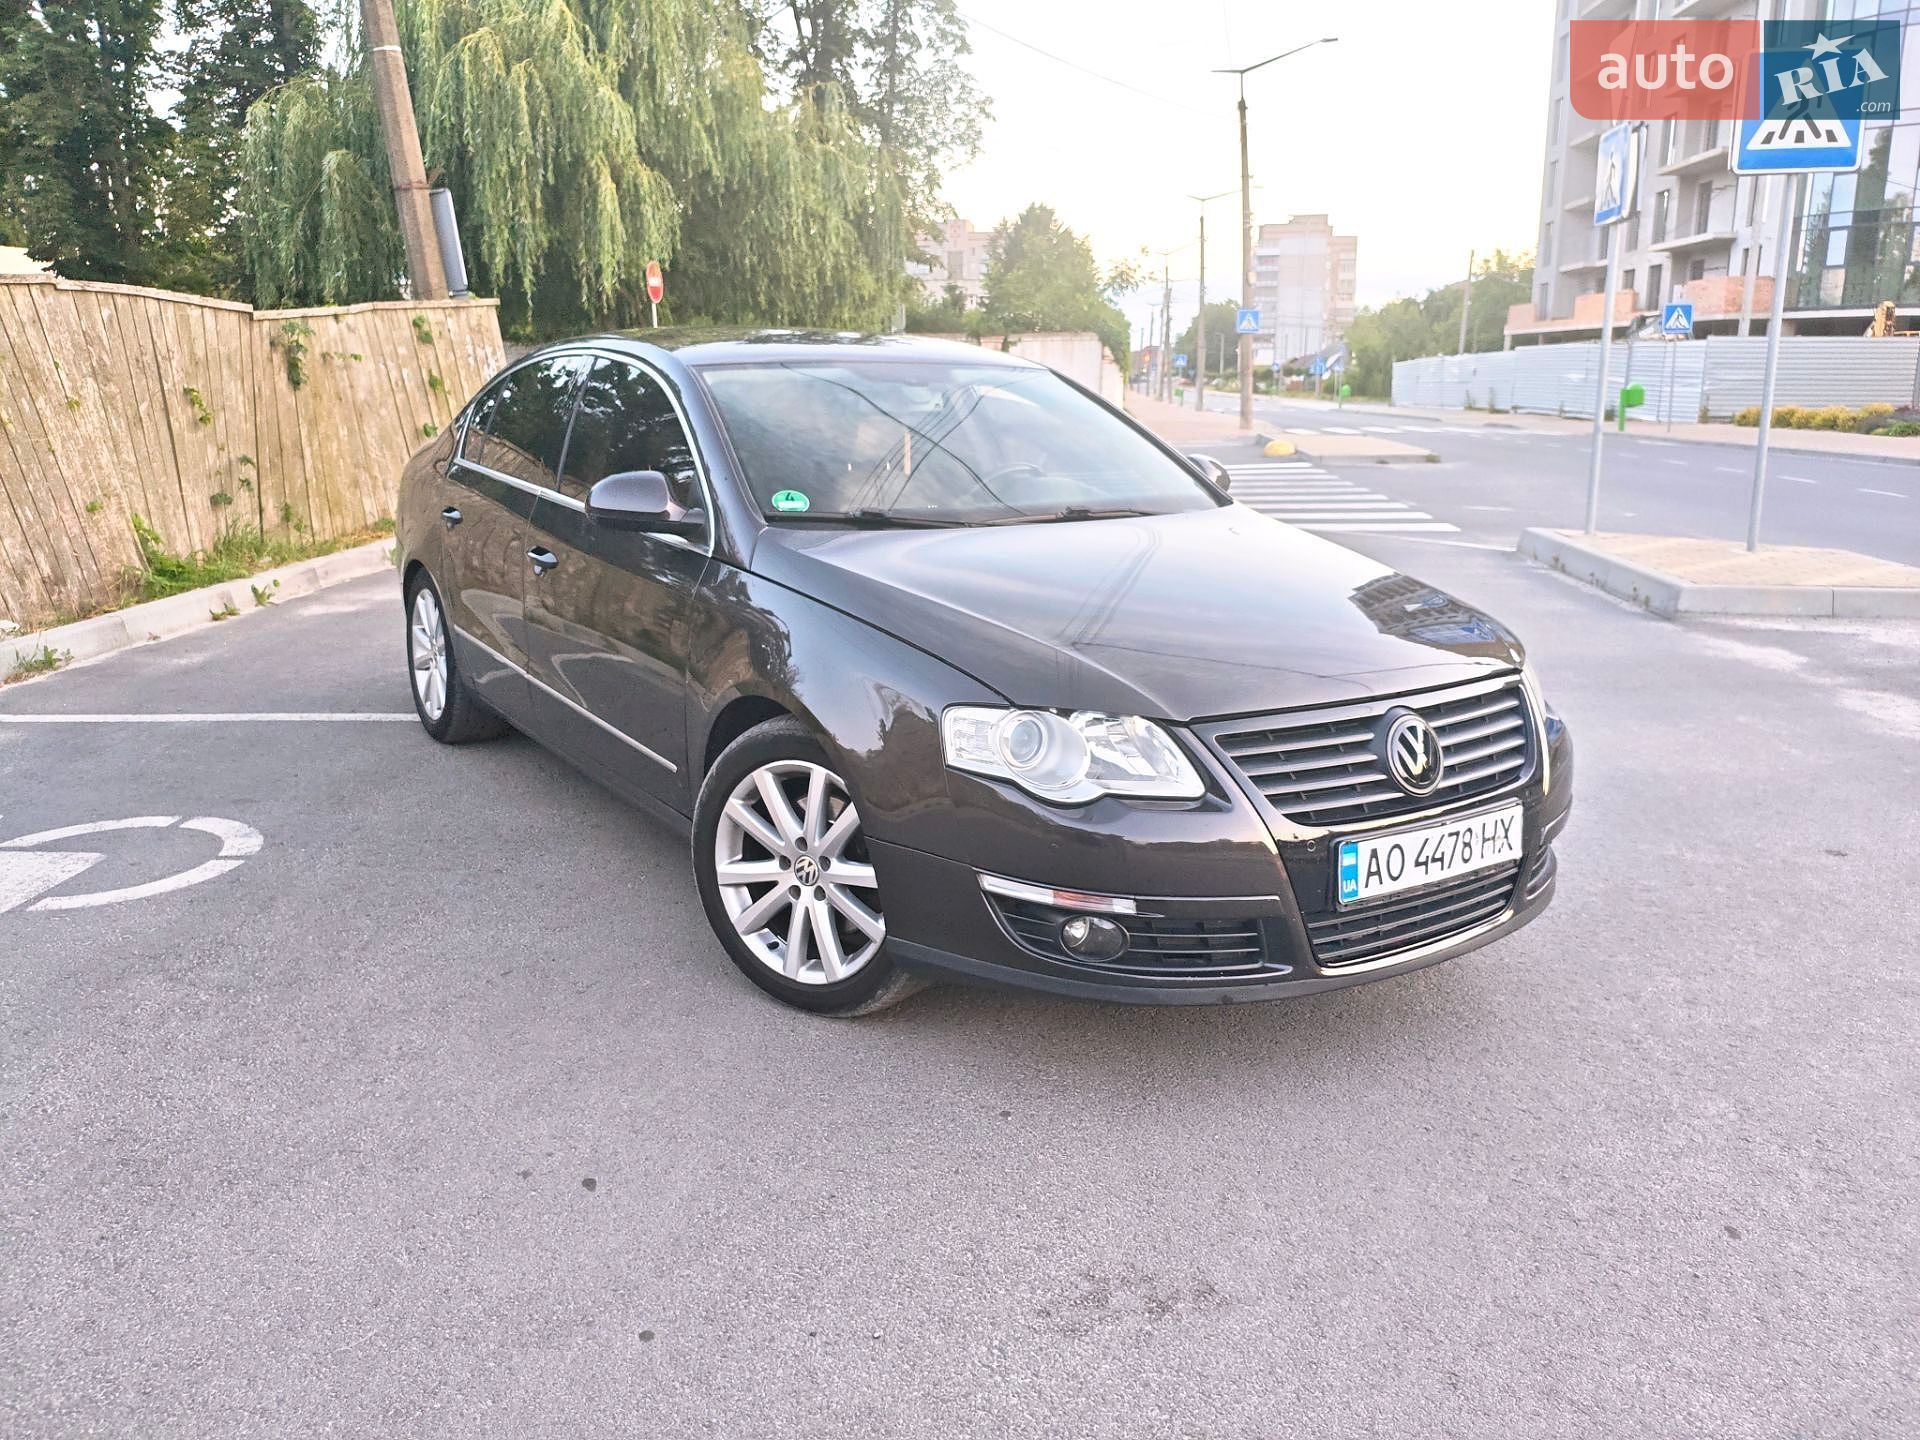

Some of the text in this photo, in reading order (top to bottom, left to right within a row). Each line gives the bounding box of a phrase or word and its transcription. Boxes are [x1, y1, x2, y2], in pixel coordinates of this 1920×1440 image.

[1364, 815, 1515, 888] AO 4478 HX
[1343, 880, 1357, 892] UA
